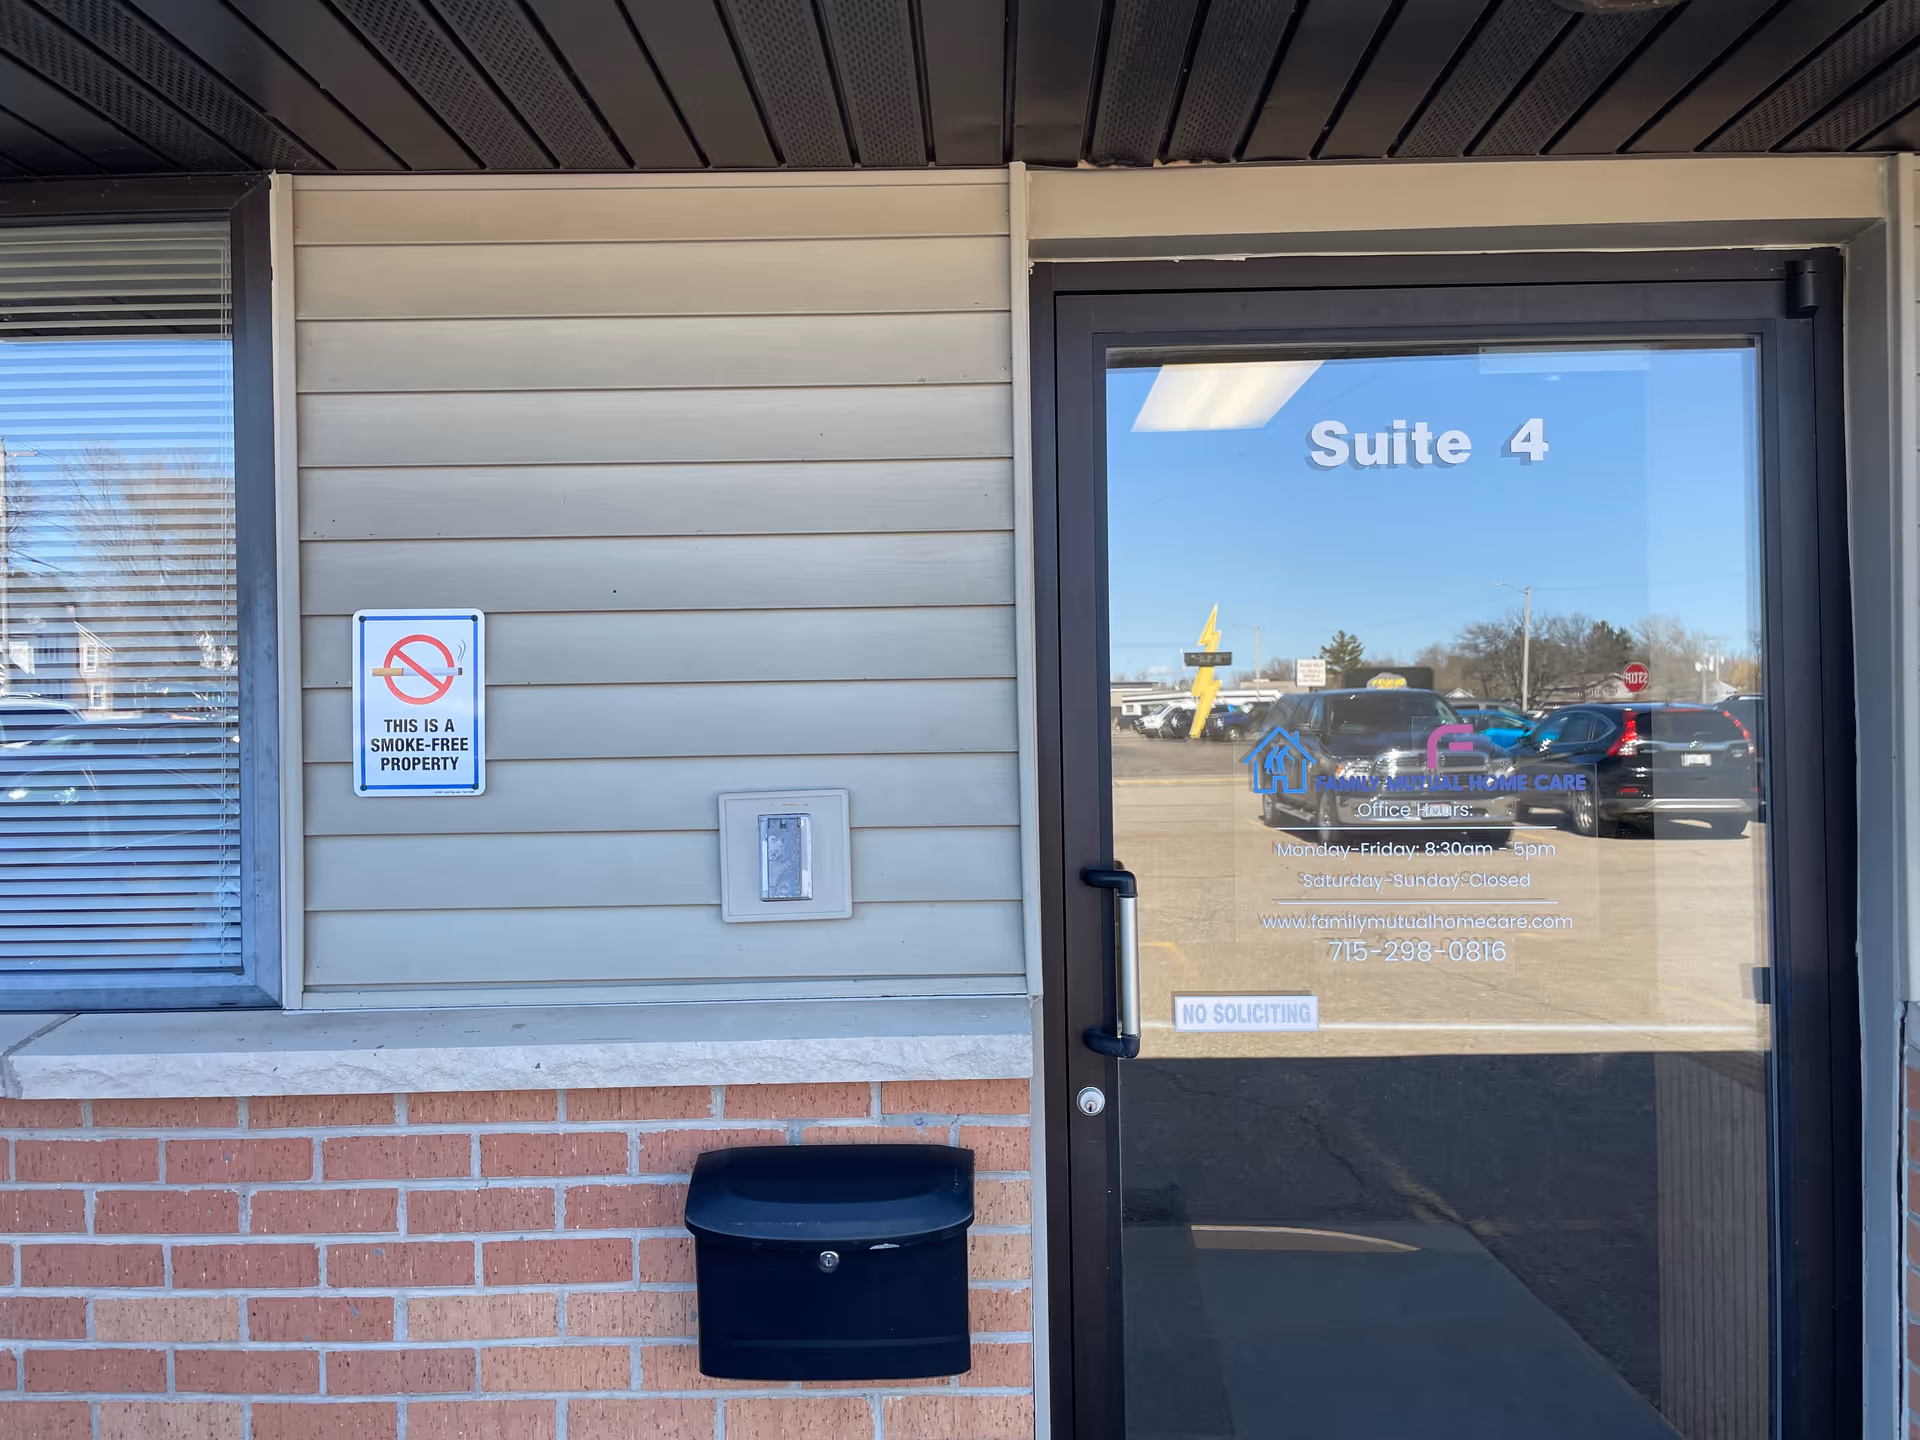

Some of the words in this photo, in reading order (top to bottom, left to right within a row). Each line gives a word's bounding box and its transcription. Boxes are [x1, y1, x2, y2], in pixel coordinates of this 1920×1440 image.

[1310, 419, 1472, 467] Suite
[1510, 418, 1549, 461] 4
[384, 718, 418, 733] THIS
[424, 718, 438, 732] IS
[444, 718, 455, 732] A
[370, 737, 468, 752] SMOKE-FREE
[380, 756, 459, 771] PROPERTY
[1316, 775, 1380, 792] FAMILY
[1386, 775, 1462, 792] MUTUAL
[1469, 774, 1528, 791] HOME
[1533, 773, 1586, 791] CARE
[1357, 802, 1411, 817] Office
[1416, 802, 1473, 817] Hours:
[1276, 841, 1420, 860] Monday-Friday:
[1425, 841, 1493, 857] 8:30am
[1513, 842, 1556, 860] 5pm
[1303, 873, 1464, 891] Saturday-Sunday:
[1469, 873, 1531, 887] Closed
[1262, 914, 1573, 933] www.familymutualhomecare.com
[1328, 940, 1506, 962] 715-298-0816
[1182, 1003, 1207, 1024] NO
[1213, 1003, 1311, 1023] SOLICITING
